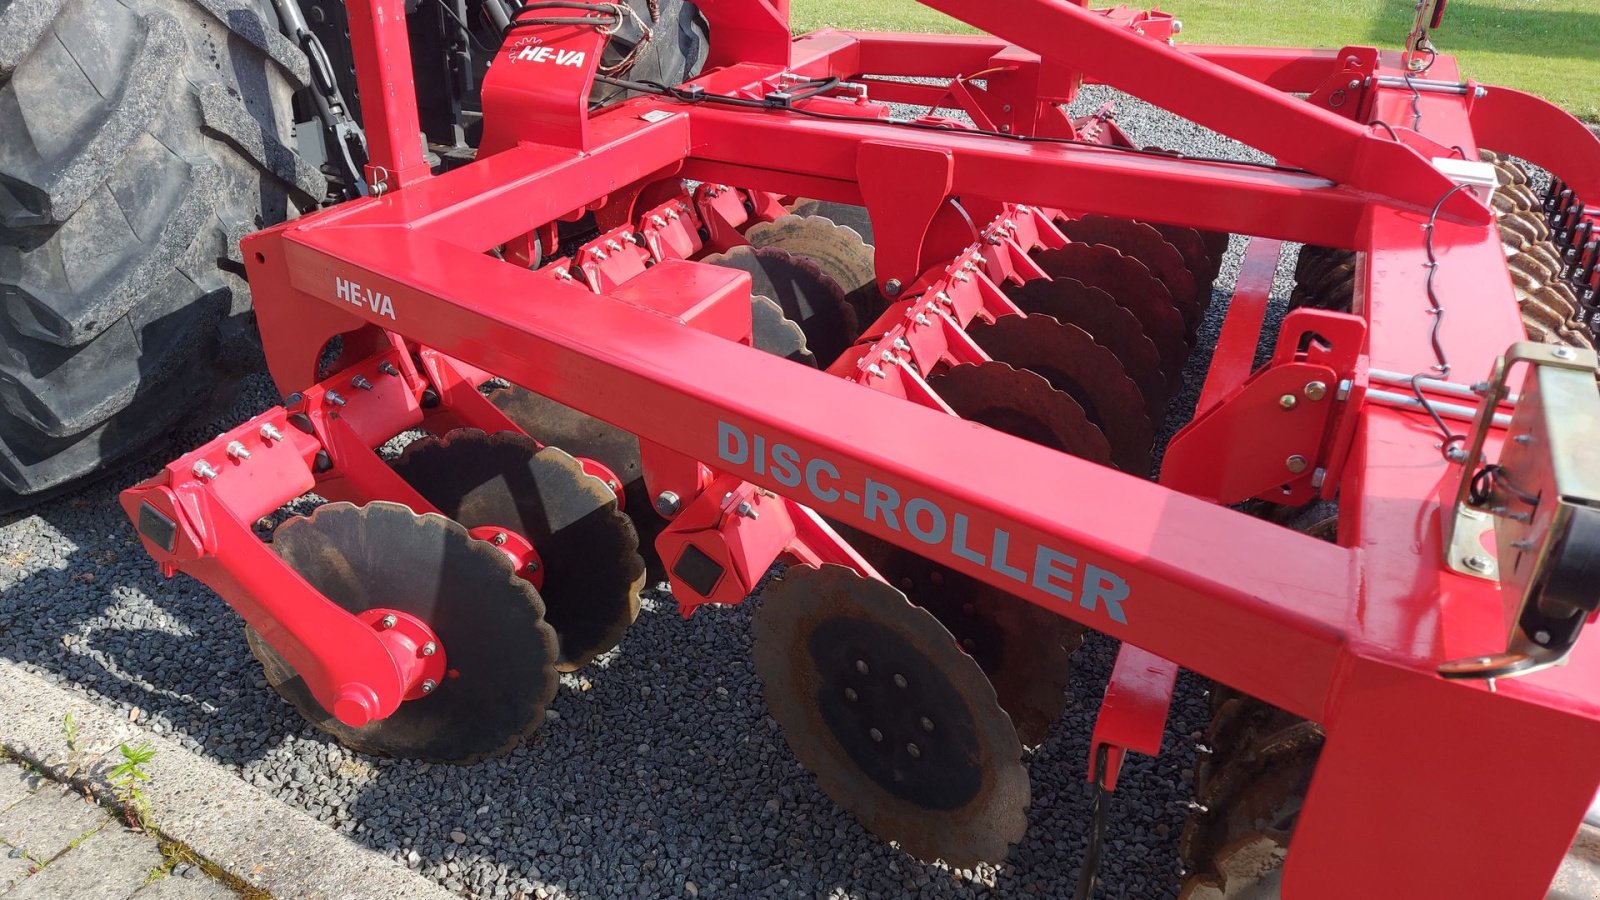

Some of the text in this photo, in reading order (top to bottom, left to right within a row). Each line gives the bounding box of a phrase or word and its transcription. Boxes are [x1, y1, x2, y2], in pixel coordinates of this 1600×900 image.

[519, 45, 586, 67] HE-VA
[336, 276, 396, 320] HE-VA
[718, 421, 1131, 624] DISC-ROLLER
